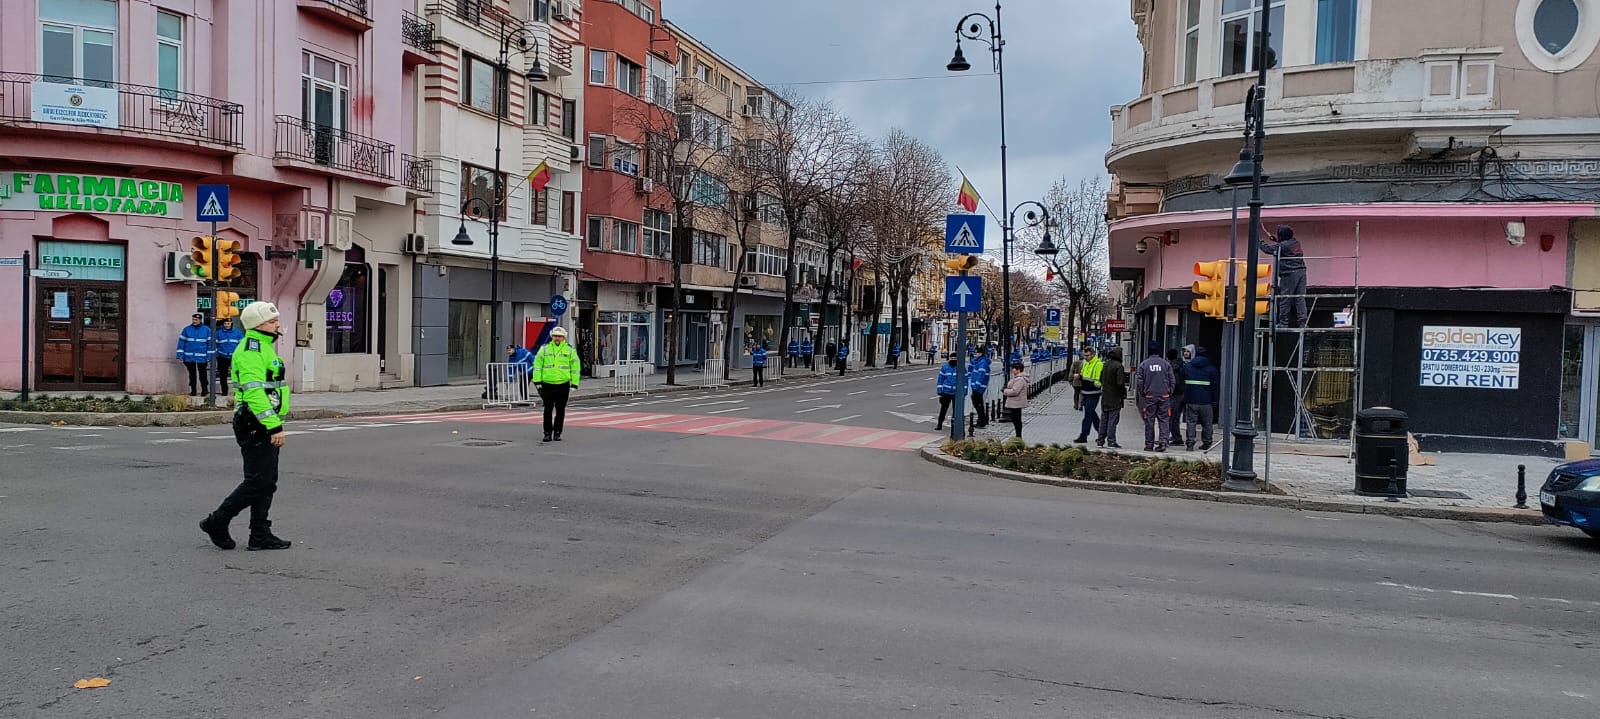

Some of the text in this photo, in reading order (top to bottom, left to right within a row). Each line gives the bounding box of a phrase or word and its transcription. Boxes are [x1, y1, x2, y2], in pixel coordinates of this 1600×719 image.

[13, 173, 183, 203] FARMACIA
[38, 194, 168, 216] HELIOFARM
[42, 255, 121, 267] FARMACIE
[326, 311, 353, 322] IRESC
[1049, 310, 1058, 321] P
[1424, 328, 1520, 349] goldenkey
[1423, 349, 1519, 363] 0735.429.900
[1440, 364, 1470, 373] COMERCIAL
[1421, 372, 1517, 388] FOR RENT
